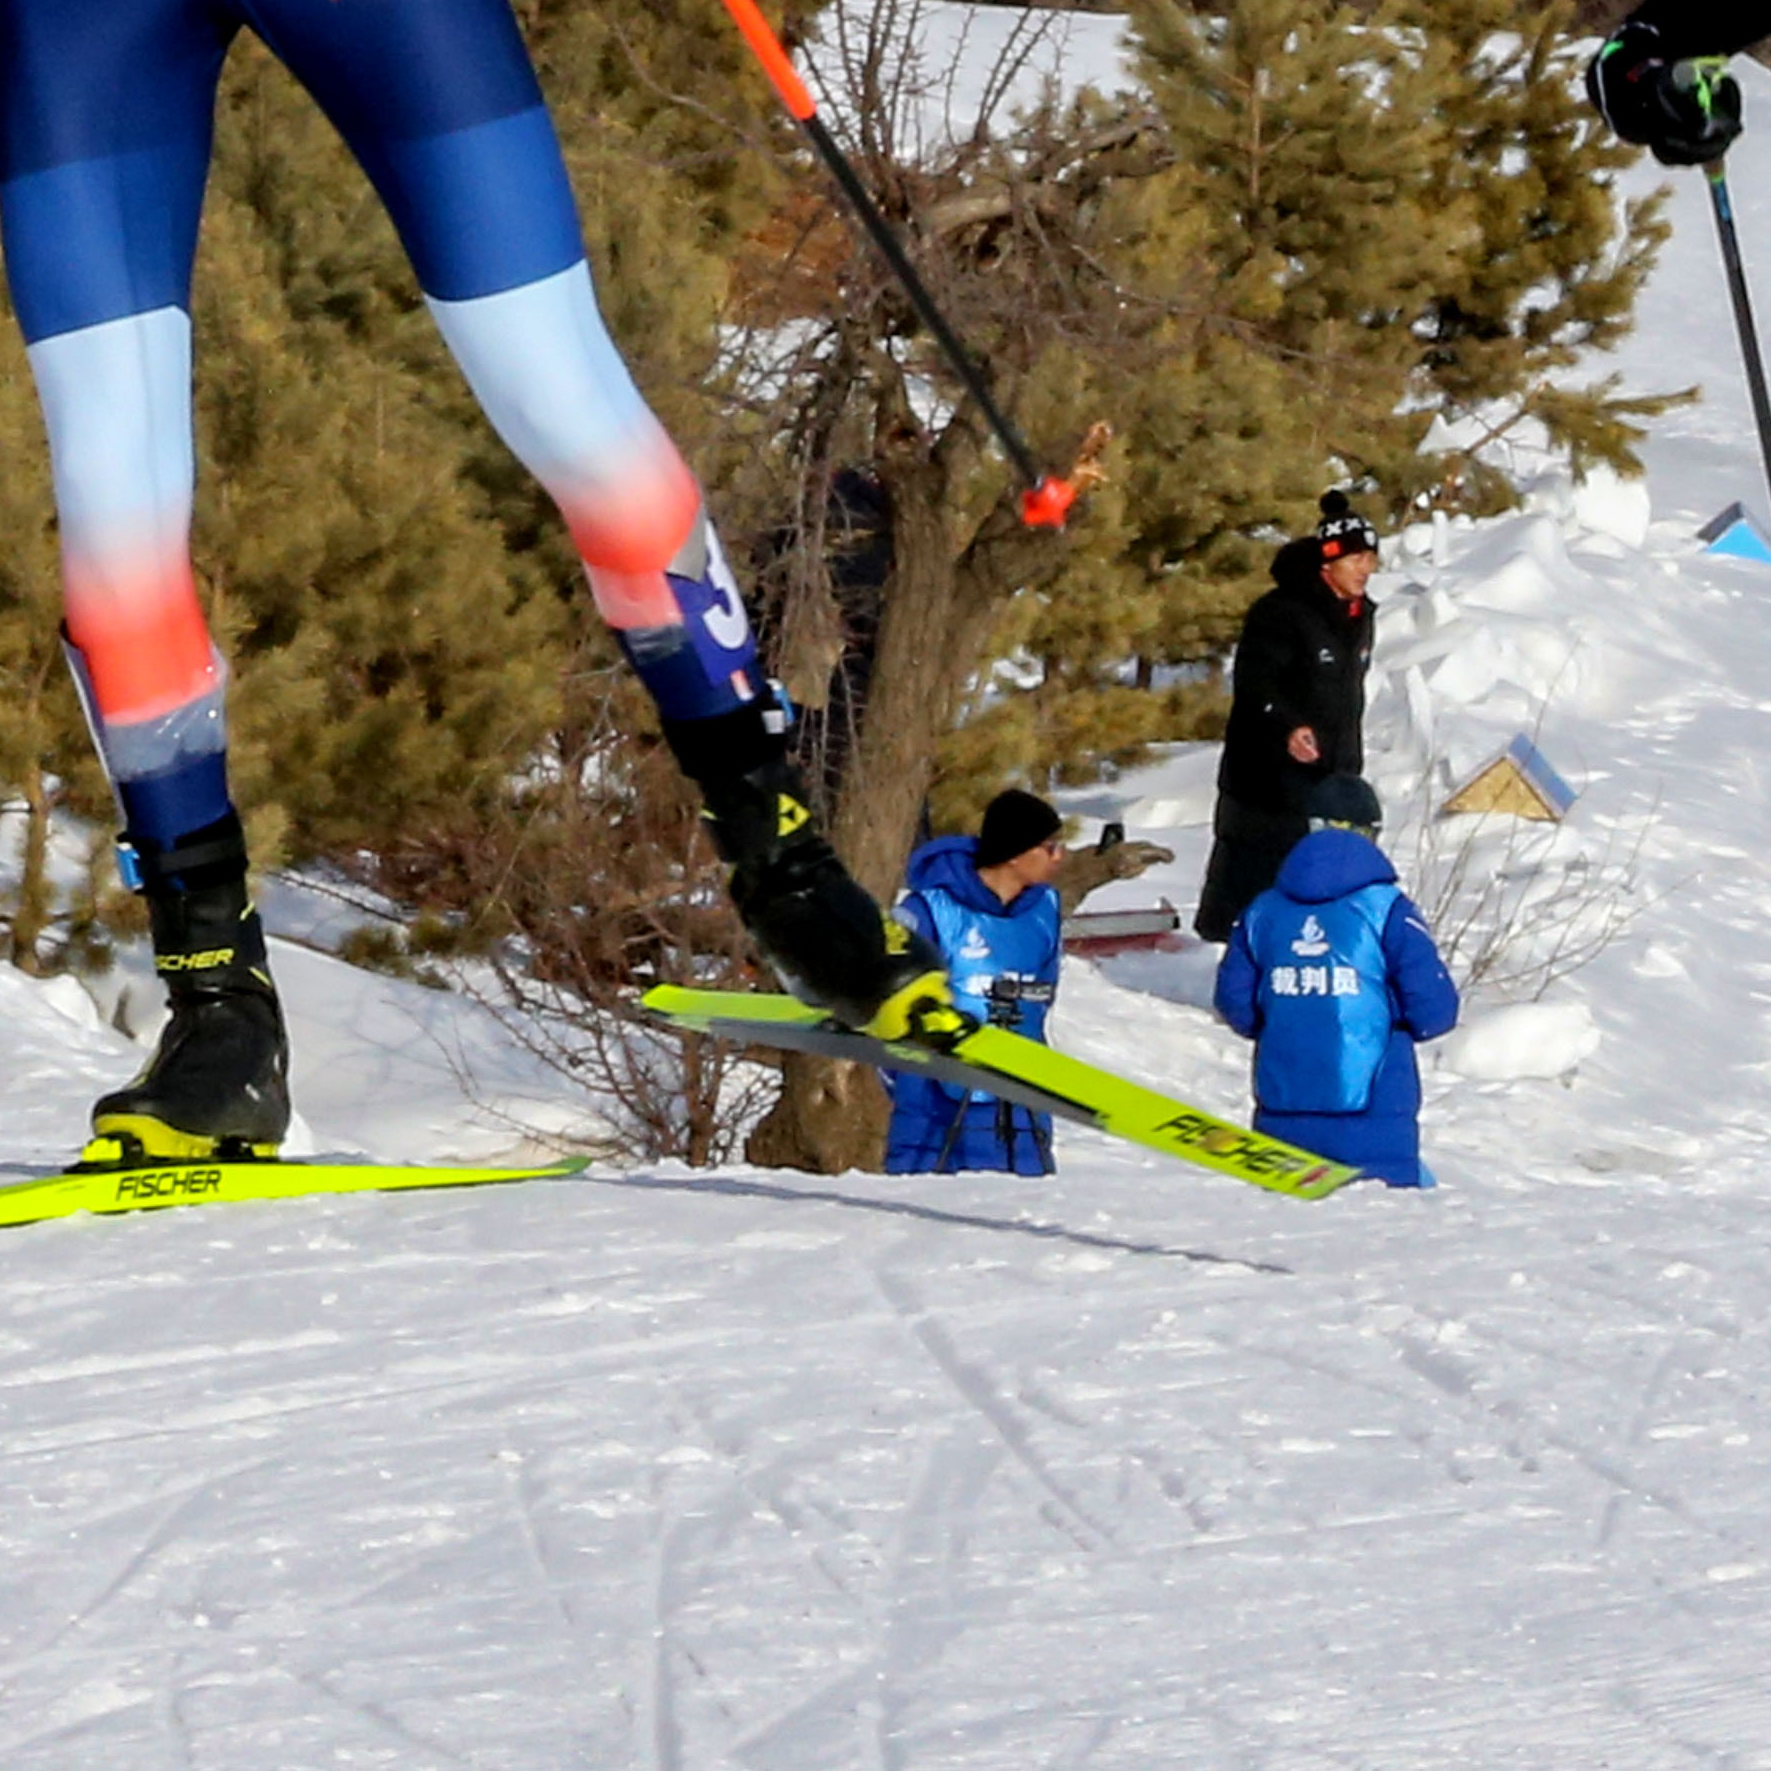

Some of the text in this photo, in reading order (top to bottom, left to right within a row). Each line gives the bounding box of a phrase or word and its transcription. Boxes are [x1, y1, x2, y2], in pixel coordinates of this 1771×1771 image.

[1271, 966, 1361, 996] 裁判员
[115, 1169, 222, 1202] FISCHER
